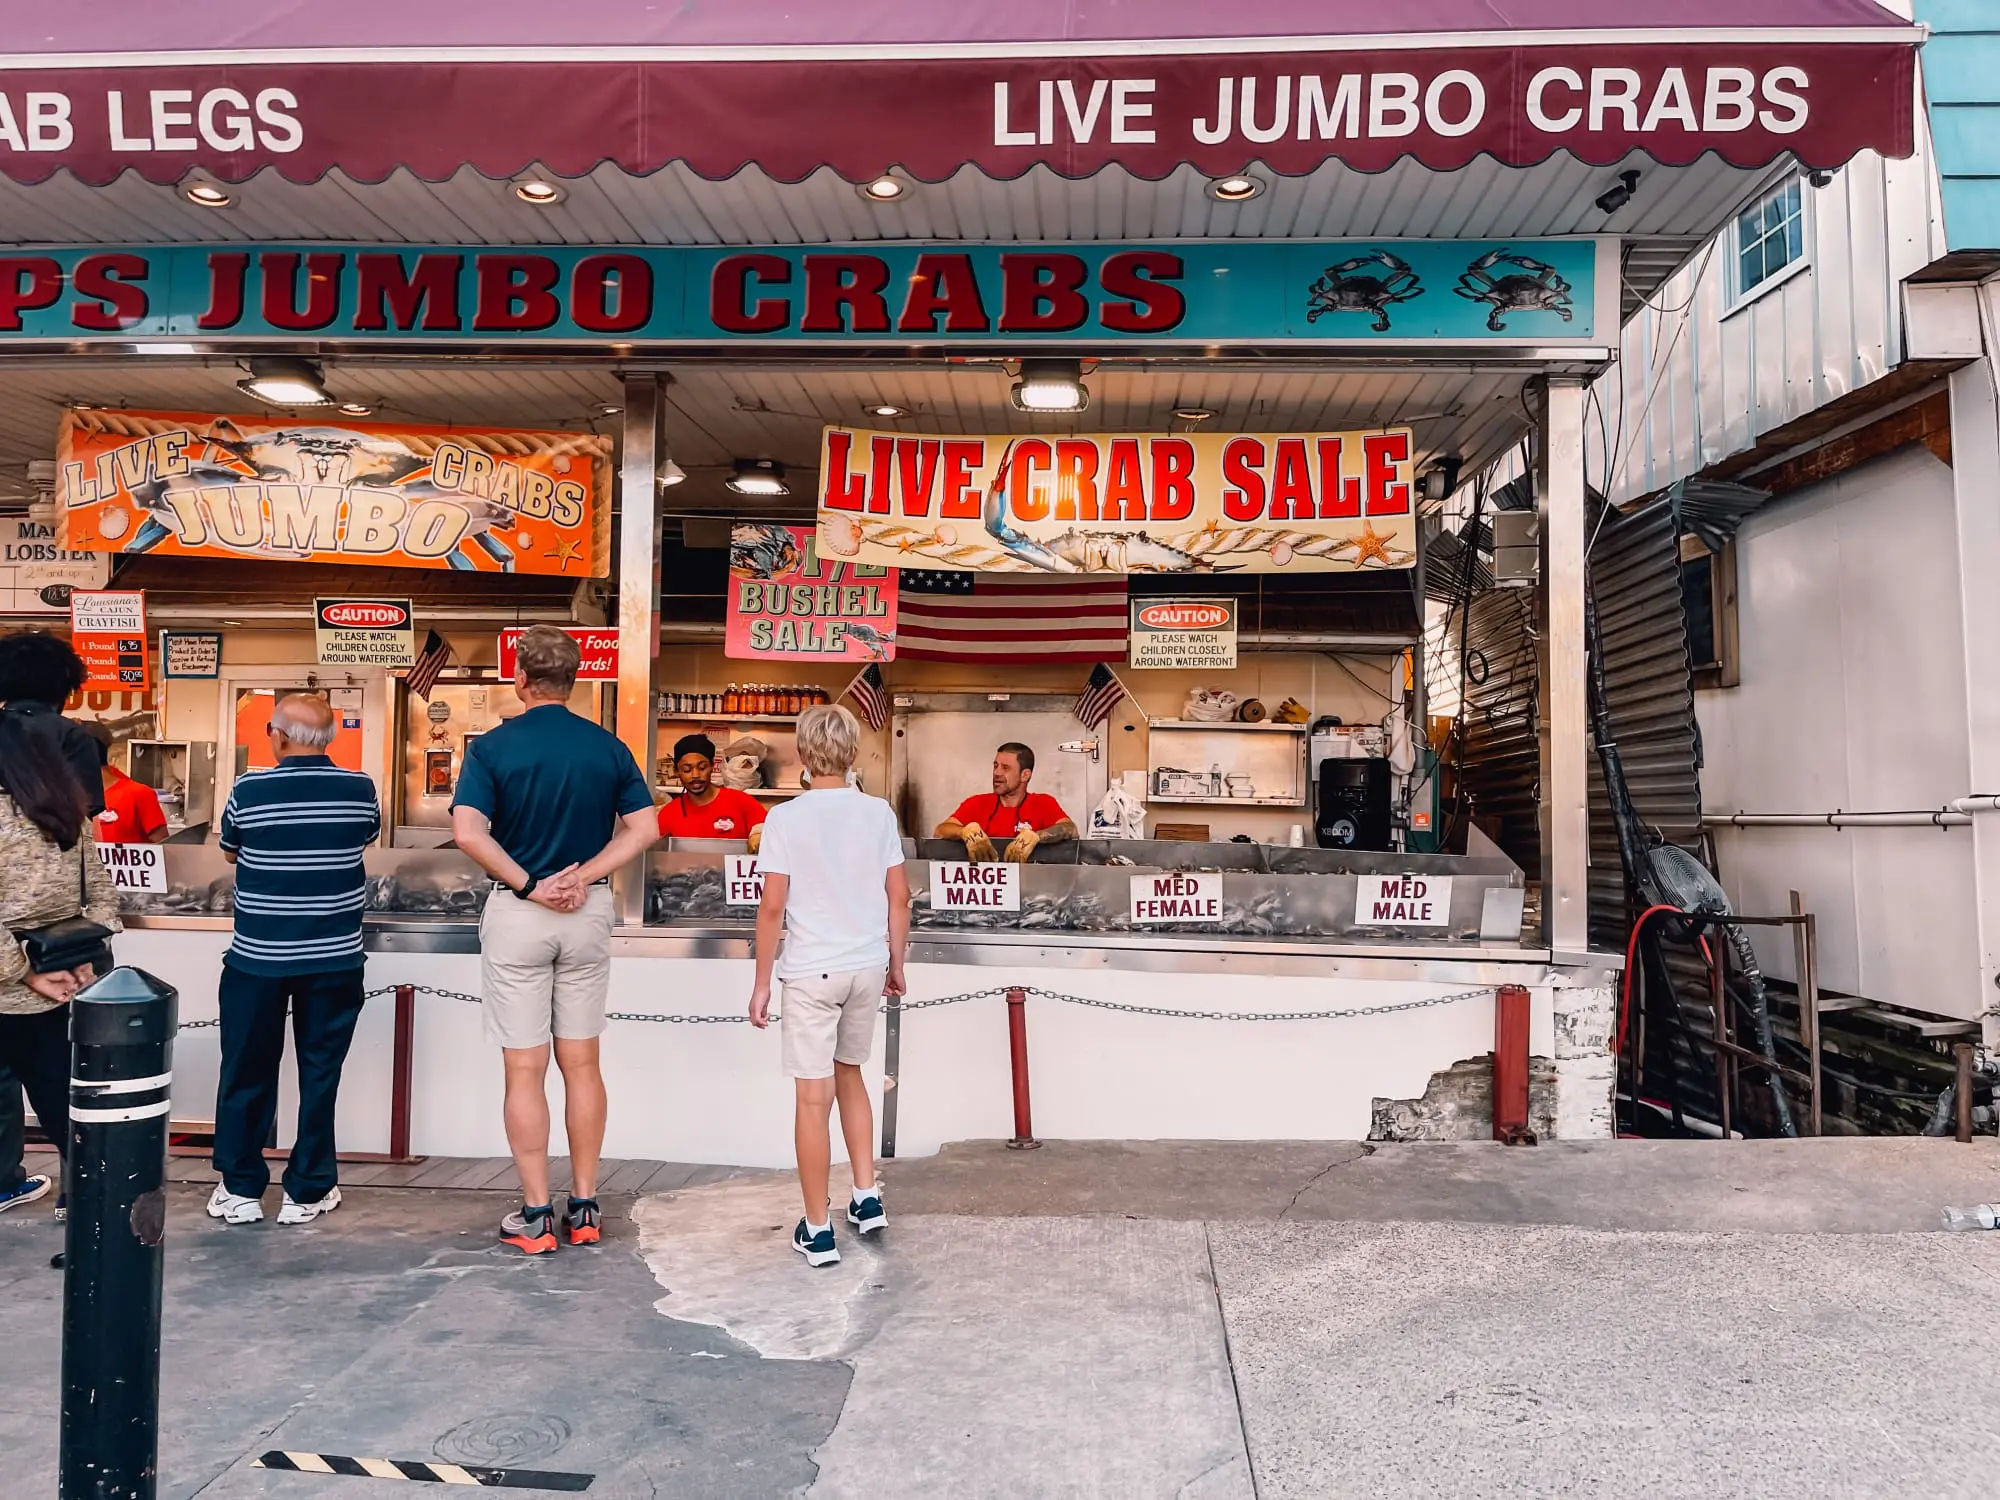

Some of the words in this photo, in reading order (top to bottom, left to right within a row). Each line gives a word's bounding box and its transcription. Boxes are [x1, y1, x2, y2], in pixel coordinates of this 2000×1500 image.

[993, 79, 1156, 146] LIVE
[1192, 70, 1486, 145] JUMBO
[1526, 66, 1810, 134] CRABS
[0, 92, 73, 152] AB
[107, 88, 302, 152] LEGS
[0, 252, 149, 332] PS
[197, 252, 655, 333] JUMBO
[709, 251, 1188, 333] CRABS
[64, 431, 190, 508] LIVE
[824, 431, 983, 519] LIVE
[1011, 438, 1195, 521] CRAB
[1223, 433, 1410, 522] SALE
[431, 444, 585, 528] CRABS
[164, 484, 472, 558] JUMBO
[18, 522, 56, 539] MAI
[6, 544, 97, 561] LOBSTER
[73, 596, 140, 611] Louisiana's
[739, 582, 887, 616] BUSHEL
[79, 617, 136, 628] CRAYFISH
[329, 609, 399, 622] CAUTION
[1146, 610, 1222, 624] CAUTION
[334, 632, 367, 641] PLEASE
[369, 633, 396, 641] WATCH
[750, 619, 848, 652] SALE
[1150, 635, 1184, 643] PLEASE
[1187, 634, 1217, 643] WATCH
[88, 641, 115, 650] Pound
[326, 643, 368, 651] CHILDREN
[370, 644, 405, 652] CLOSELY
[1141, 646, 1184, 654] CHILDREN
[1187, 645, 1227, 654] CLOSELY
[86, 657, 116, 666] Pounds
[321, 653, 356, 662] AROUND
[358, 655, 412, 664] WATERFRONT
[577, 657, 613, 671] ards!
[1134, 658, 1172, 666] AROUND
[1175, 657, 1234, 667] WATERFRONT
[88, 672, 117, 681] Pounds
[1321, 827, 1353, 837] XBOOM
[98, 848, 156, 867] UMBO
[941, 867, 1007, 885] LARGE
[1153, 878, 1199, 897] MED
[1380, 880, 1427, 899] MED
[946, 888, 1003, 906] MALE
[1136, 900, 1218, 917] FEMALE
[1372, 902, 1433, 921] MALE
